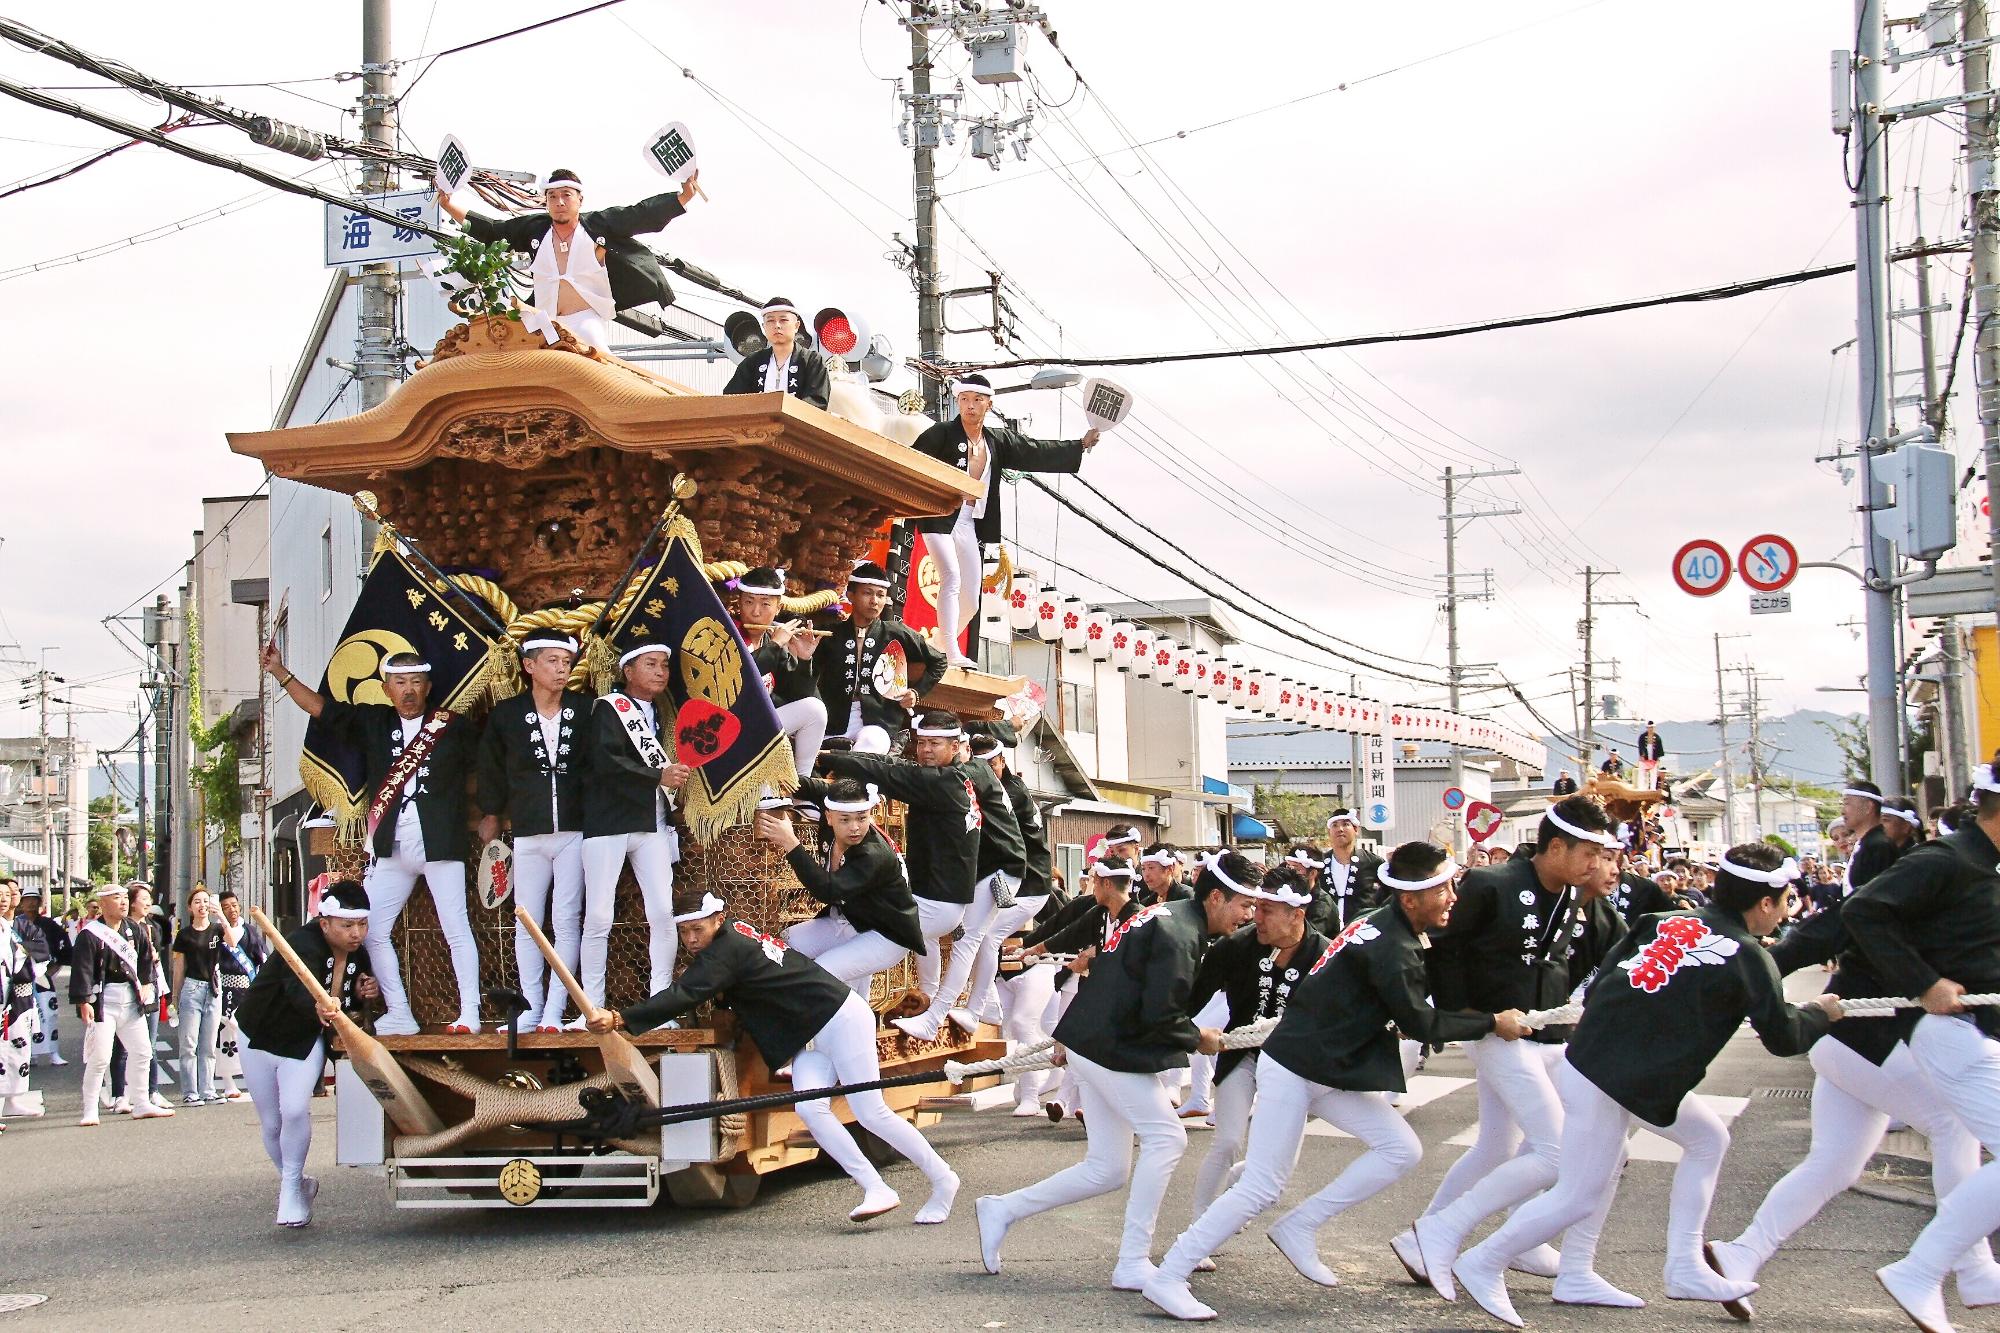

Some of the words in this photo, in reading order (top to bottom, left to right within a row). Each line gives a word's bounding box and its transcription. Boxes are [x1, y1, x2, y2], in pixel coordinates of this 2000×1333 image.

[1687, 555, 1718, 580] 40
[1751, 597, 1789, 609] ここから
[844, 653, 856, 695] 麻生中
[1371, 738, 1385, 798] 毎日新聞
[1522, 913, 1541, 966] 麻生中
